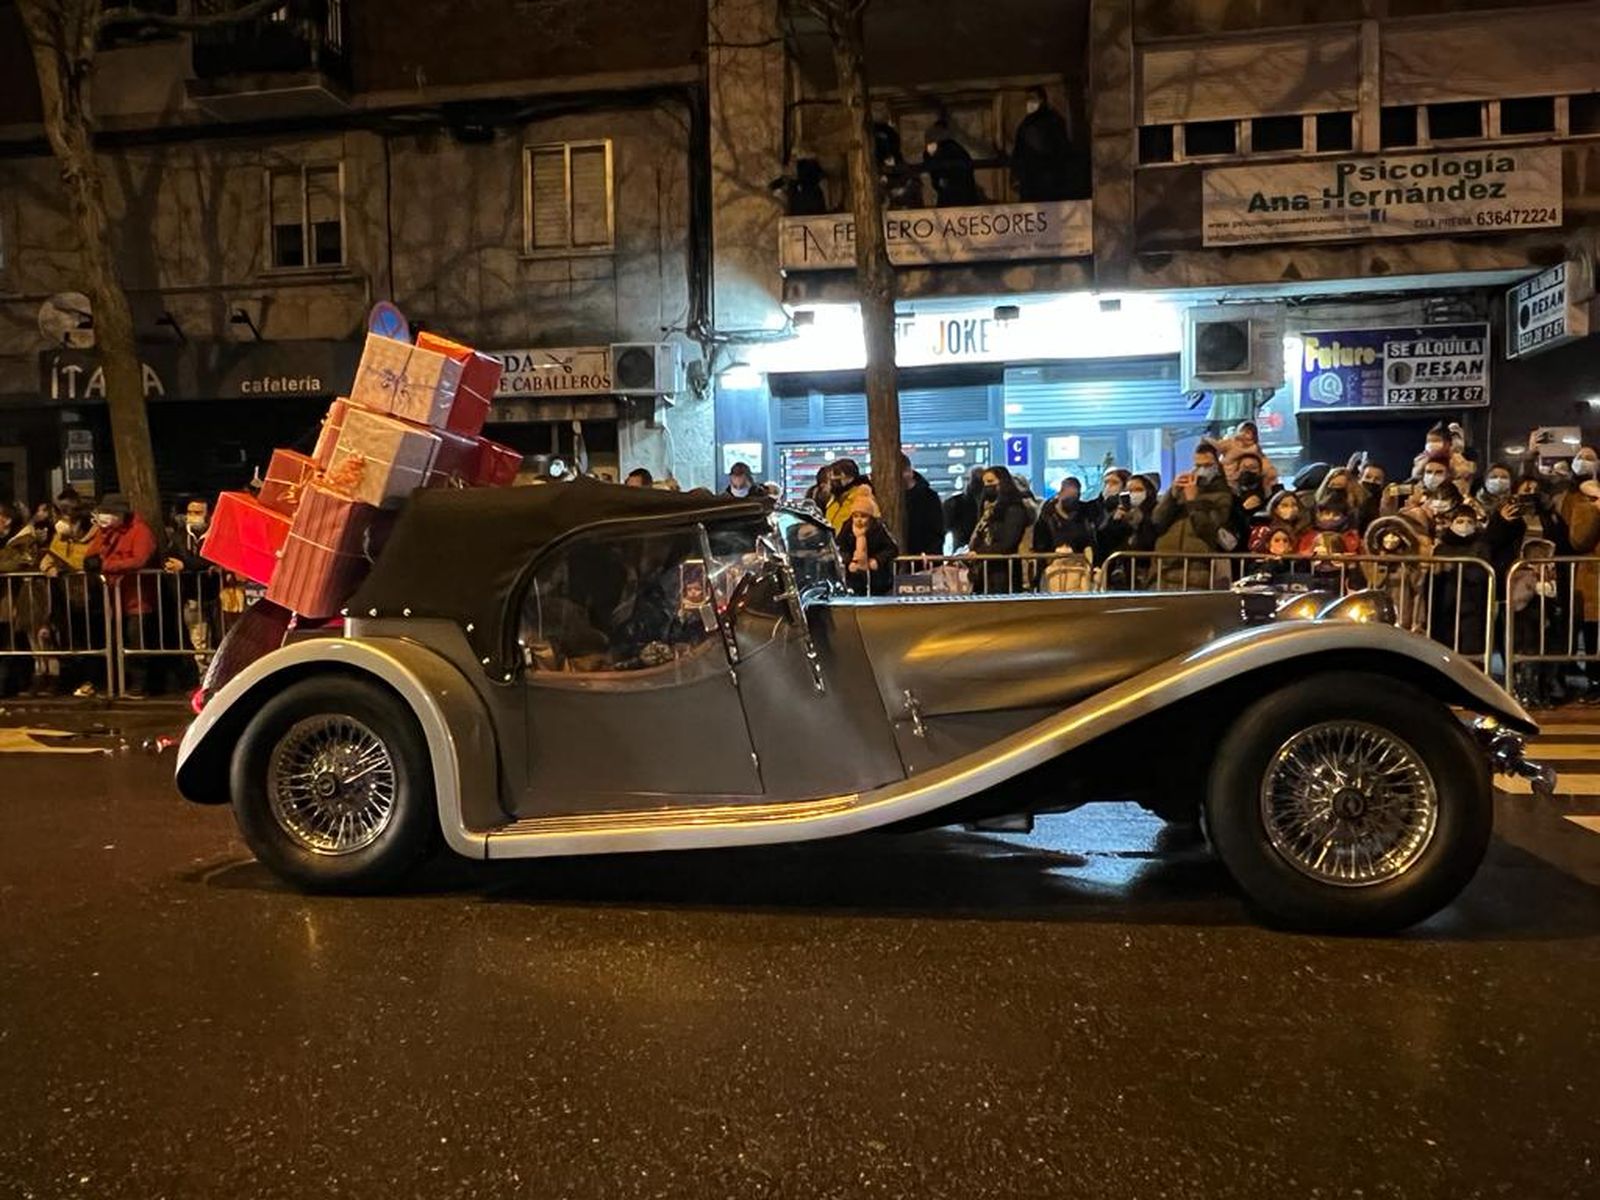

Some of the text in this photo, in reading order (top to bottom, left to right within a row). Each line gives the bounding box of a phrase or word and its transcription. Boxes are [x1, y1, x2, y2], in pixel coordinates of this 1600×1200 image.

[1337, 153, 1515, 181] Psicología
[1248, 179, 1507, 213] Ana Hernández
[834, 211, 1048, 244] FEERO ASESORES
[1477, 208, 1557, 226] 636472224
[1532, 288, 1565, 317] RESAN
[932, 318, 1006, 355] JOKE
[1389, 340, 1480, 357] SE ALQUILA
[1415, 360, 1484, 377] RESAN
[512, 374, 612, 392] CABALLEROS
[1389, 387, 1481, 403] 923 28 12 67
